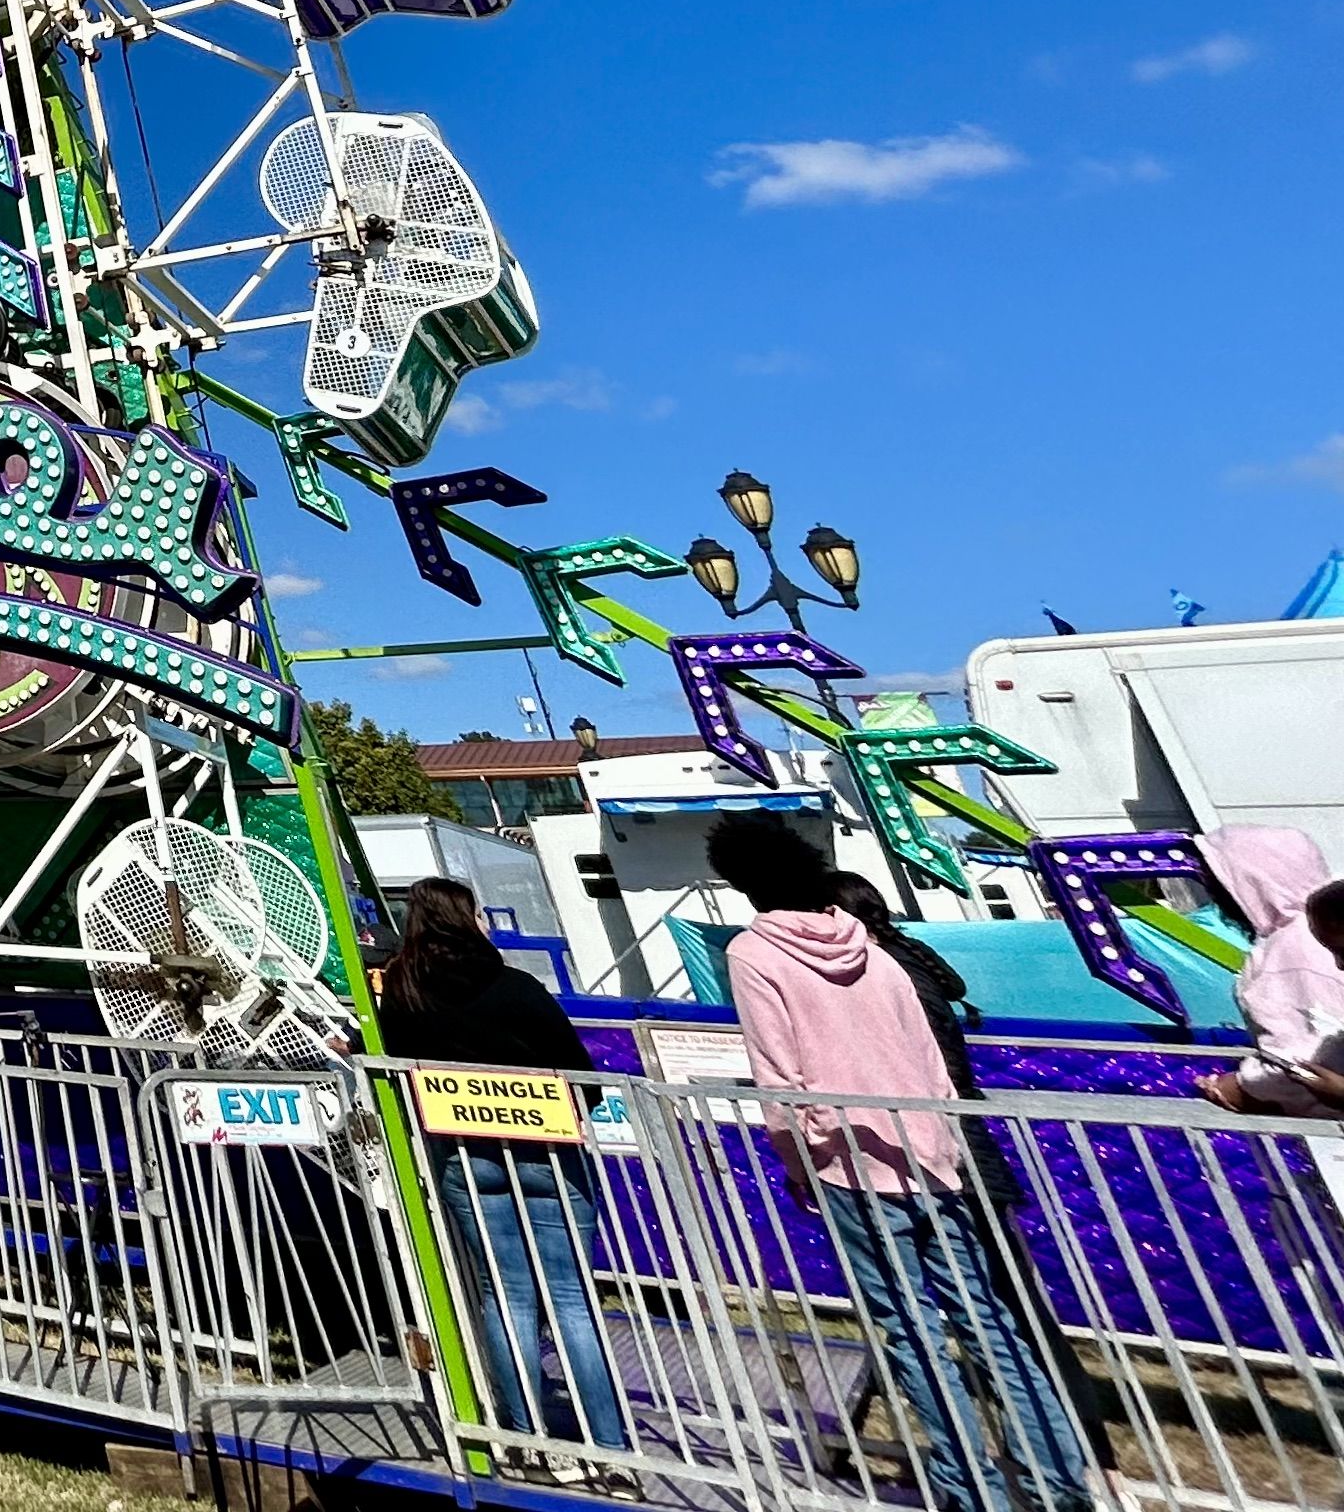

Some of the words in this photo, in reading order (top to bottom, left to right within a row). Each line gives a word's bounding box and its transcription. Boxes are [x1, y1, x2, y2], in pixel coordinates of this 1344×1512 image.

[347, 334, 357, 350] 3
[424, 1076, 459, 1094] NO
[467, 1079, 561, 1101] SINGLE
[217, 1087, 301, 1125] EXIT
[451, 1104, 544, 1126] RIDERS
